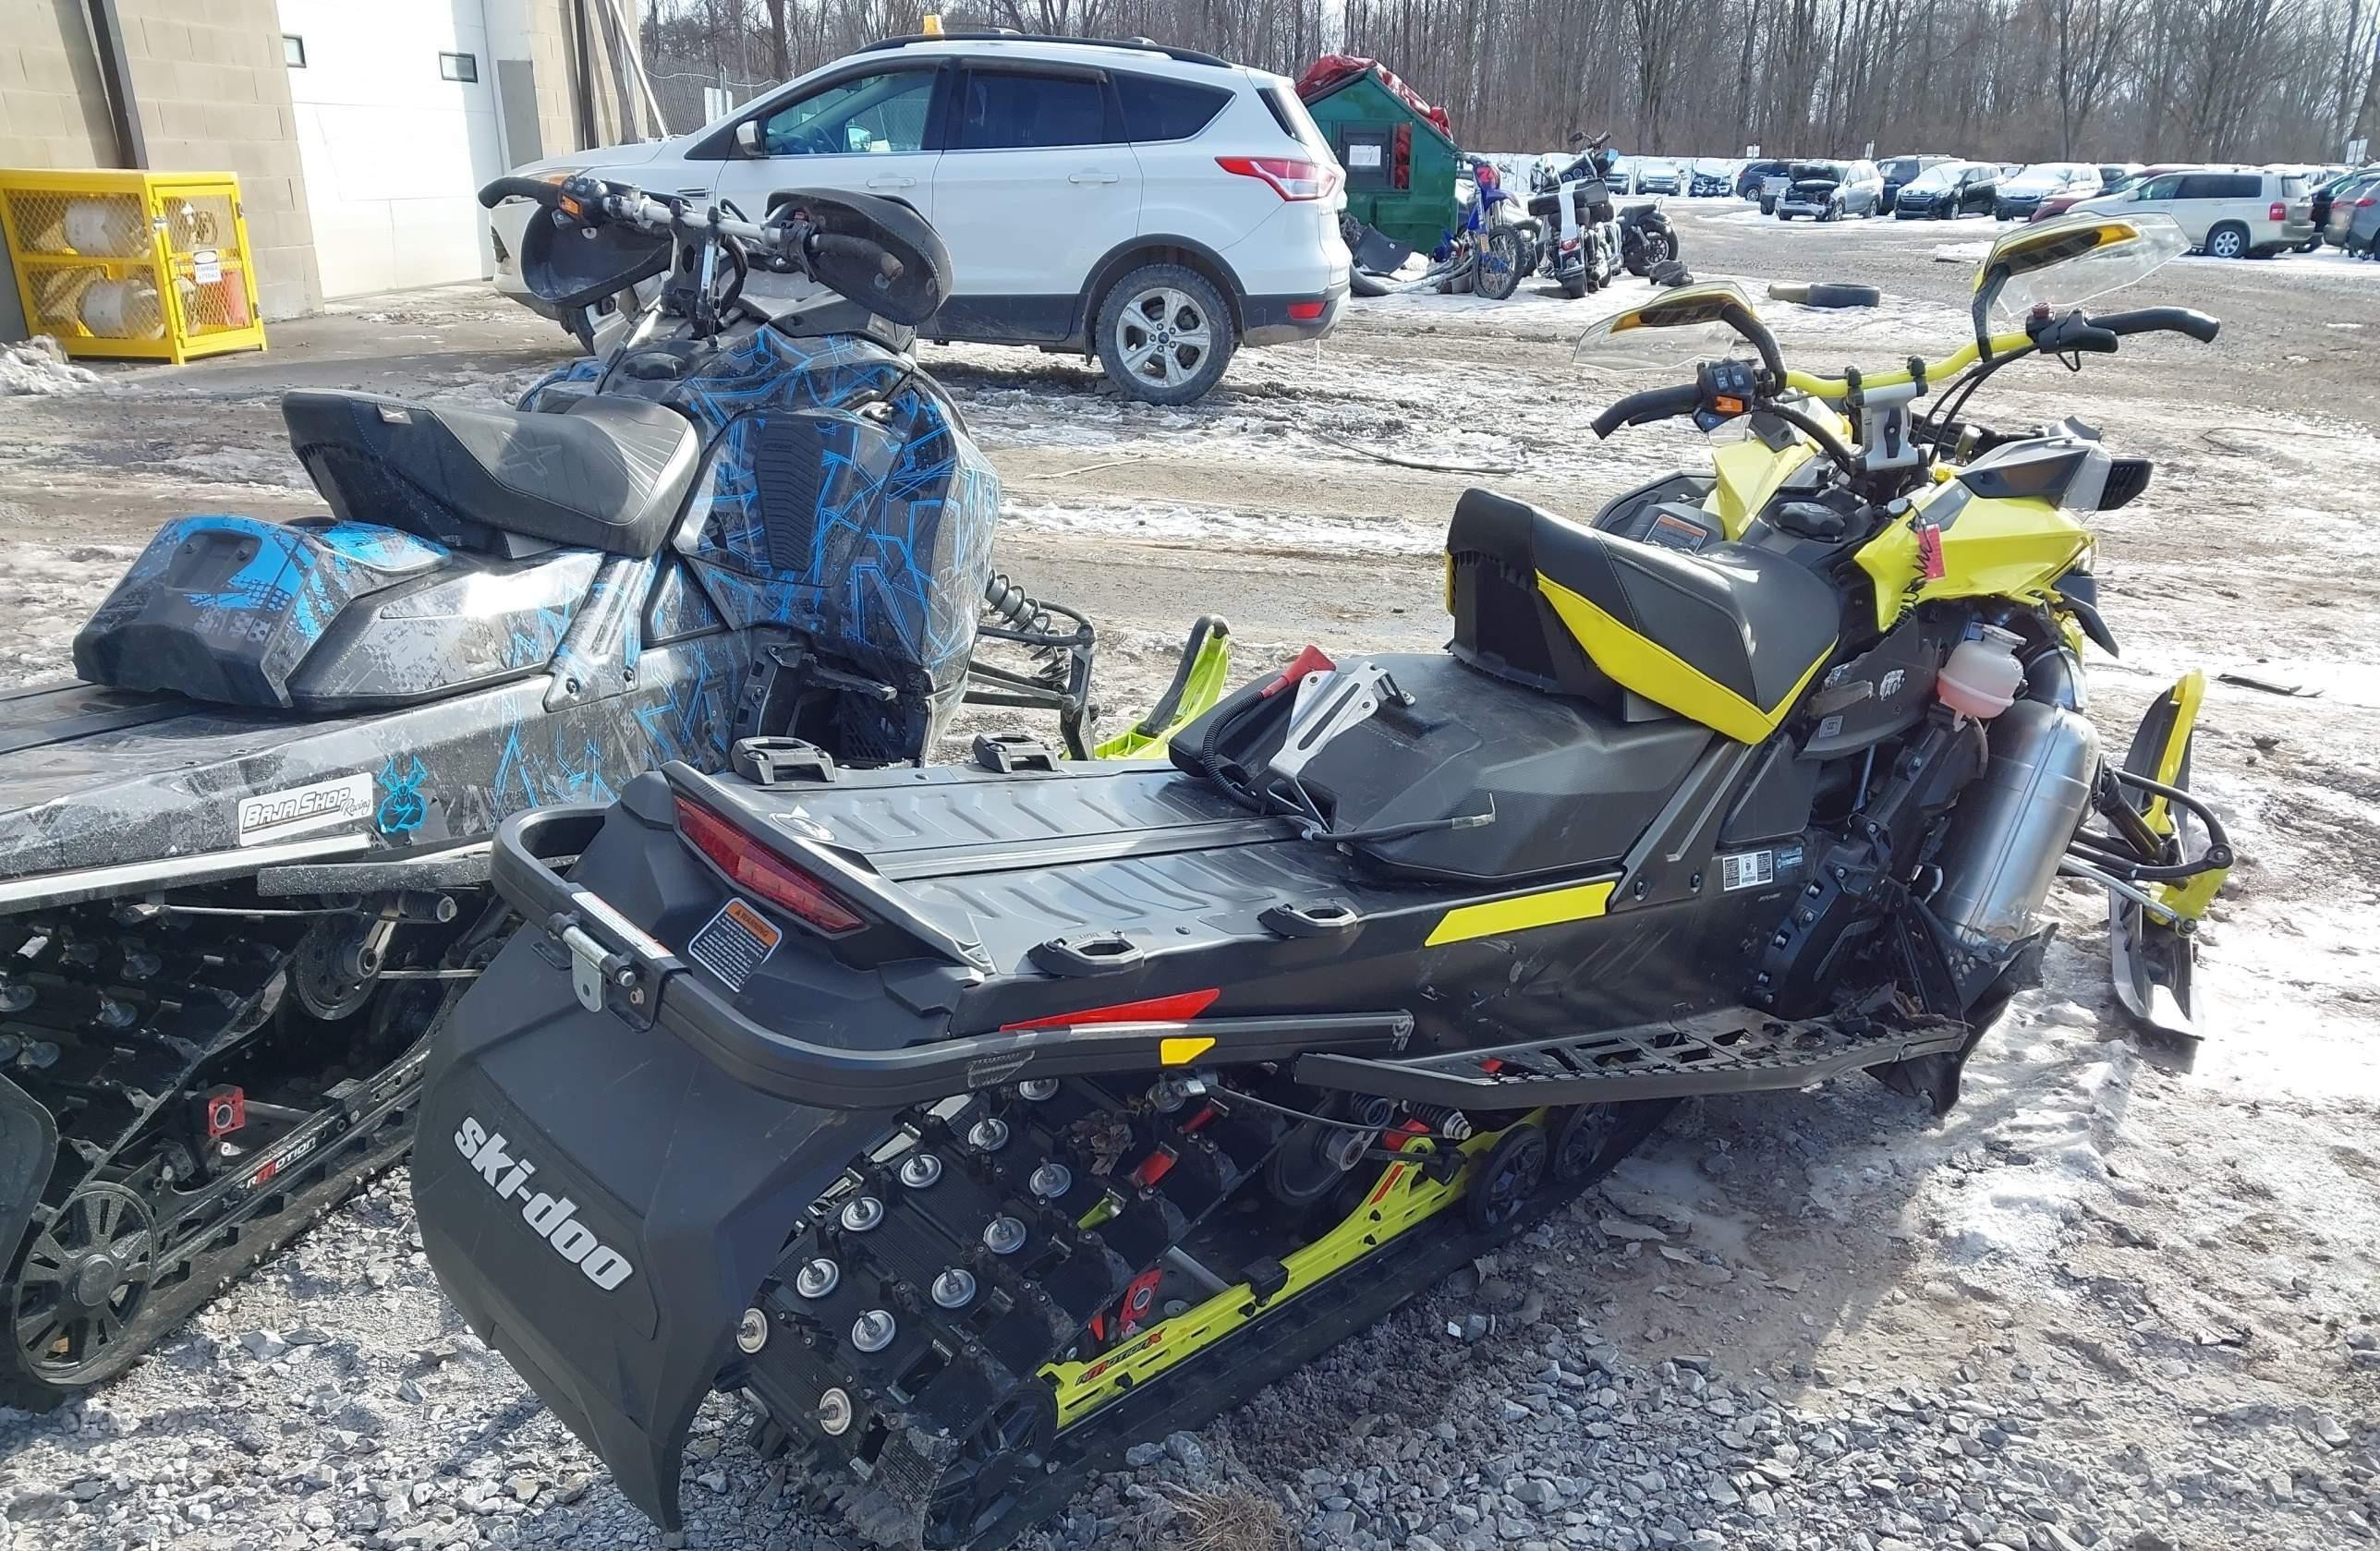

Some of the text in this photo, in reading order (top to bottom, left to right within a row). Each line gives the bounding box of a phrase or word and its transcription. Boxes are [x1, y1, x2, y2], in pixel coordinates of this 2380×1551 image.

[340, 797, 371, 818] Racing
[742, 915, 770, 939] WARNING
[454, 1116, 634, 1290] ski-doo
